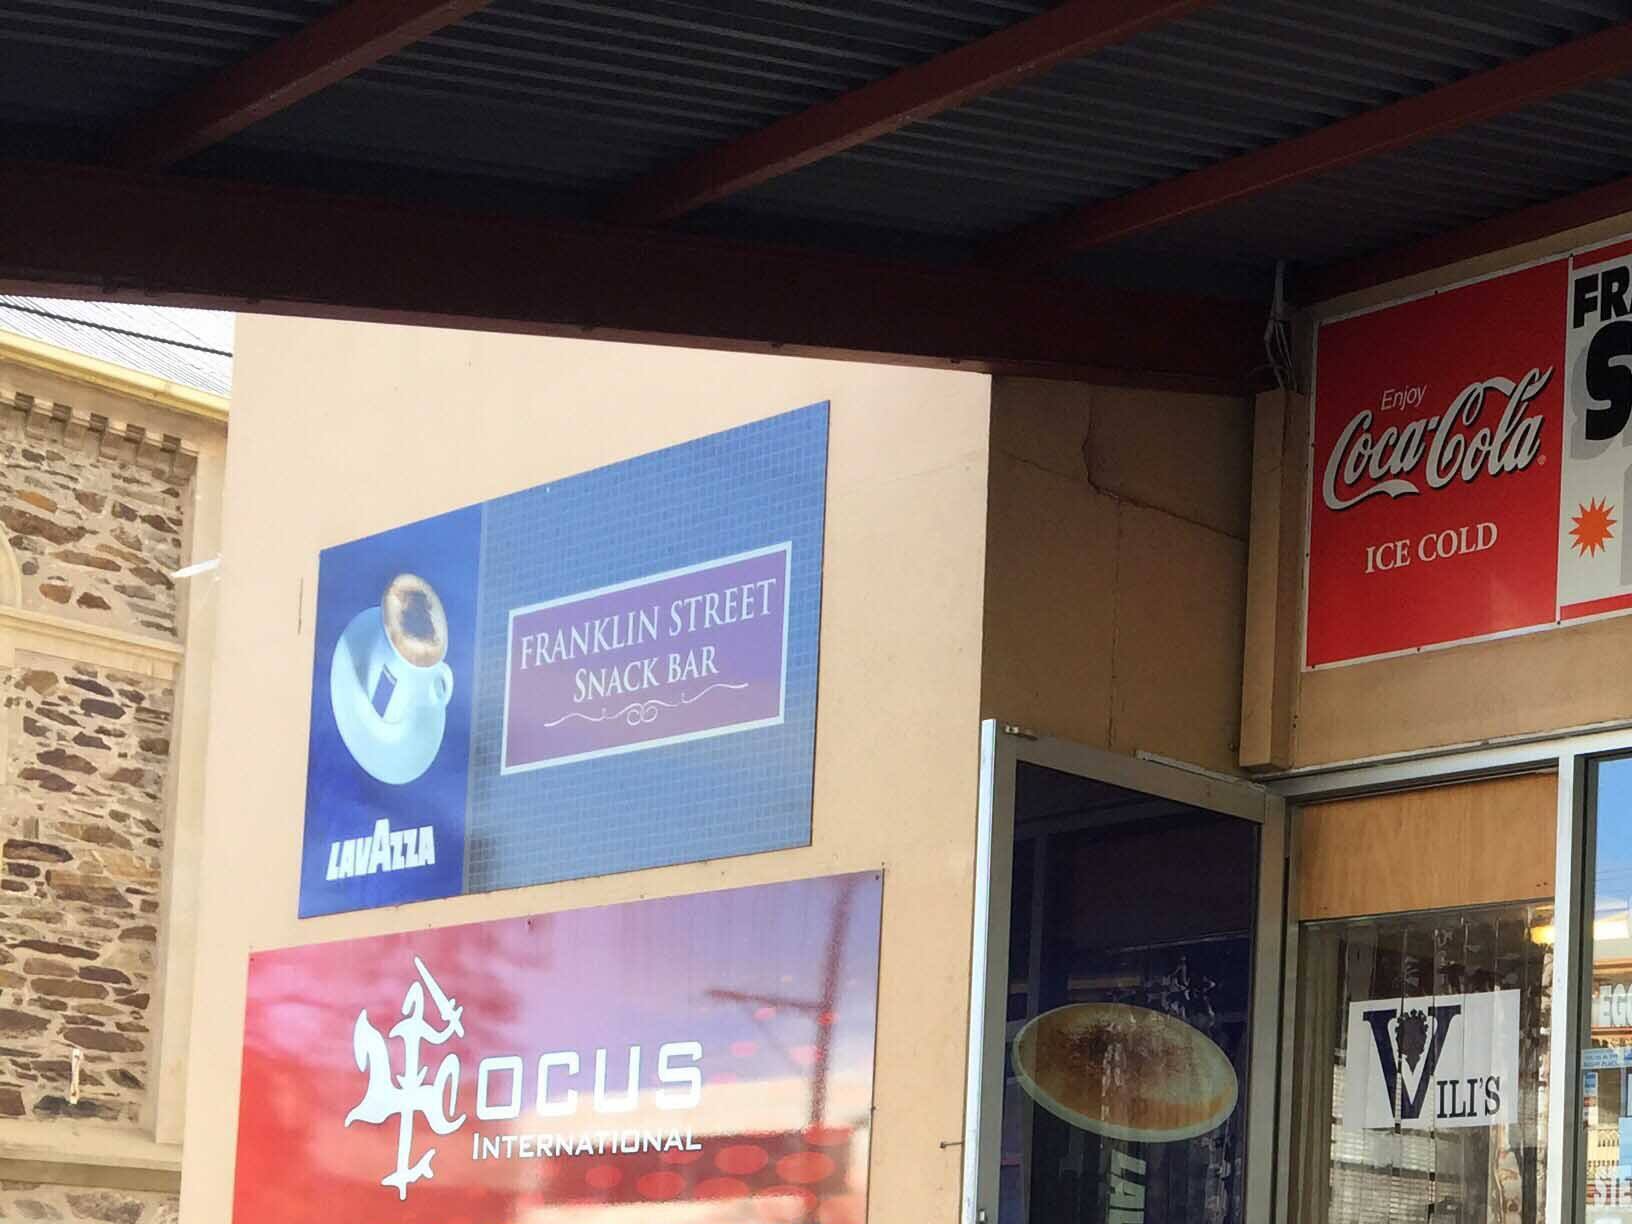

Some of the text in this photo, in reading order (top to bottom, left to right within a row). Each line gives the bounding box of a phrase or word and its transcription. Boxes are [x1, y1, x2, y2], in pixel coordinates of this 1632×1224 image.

[1380, 383, 1427, 411] Enjoy
[1323, 366, 1553, 510] Coca-Cola
[1364, 522, 1498, 574] ICE COLD
[519, 578, 778, 672] FRANKLIN STREET
[573, 646, 718, 704] SNACK BAR
[326, 818, 436, 882] LAVAZZA
[472, 1128, 702, 1161] INTERNATIONAL
